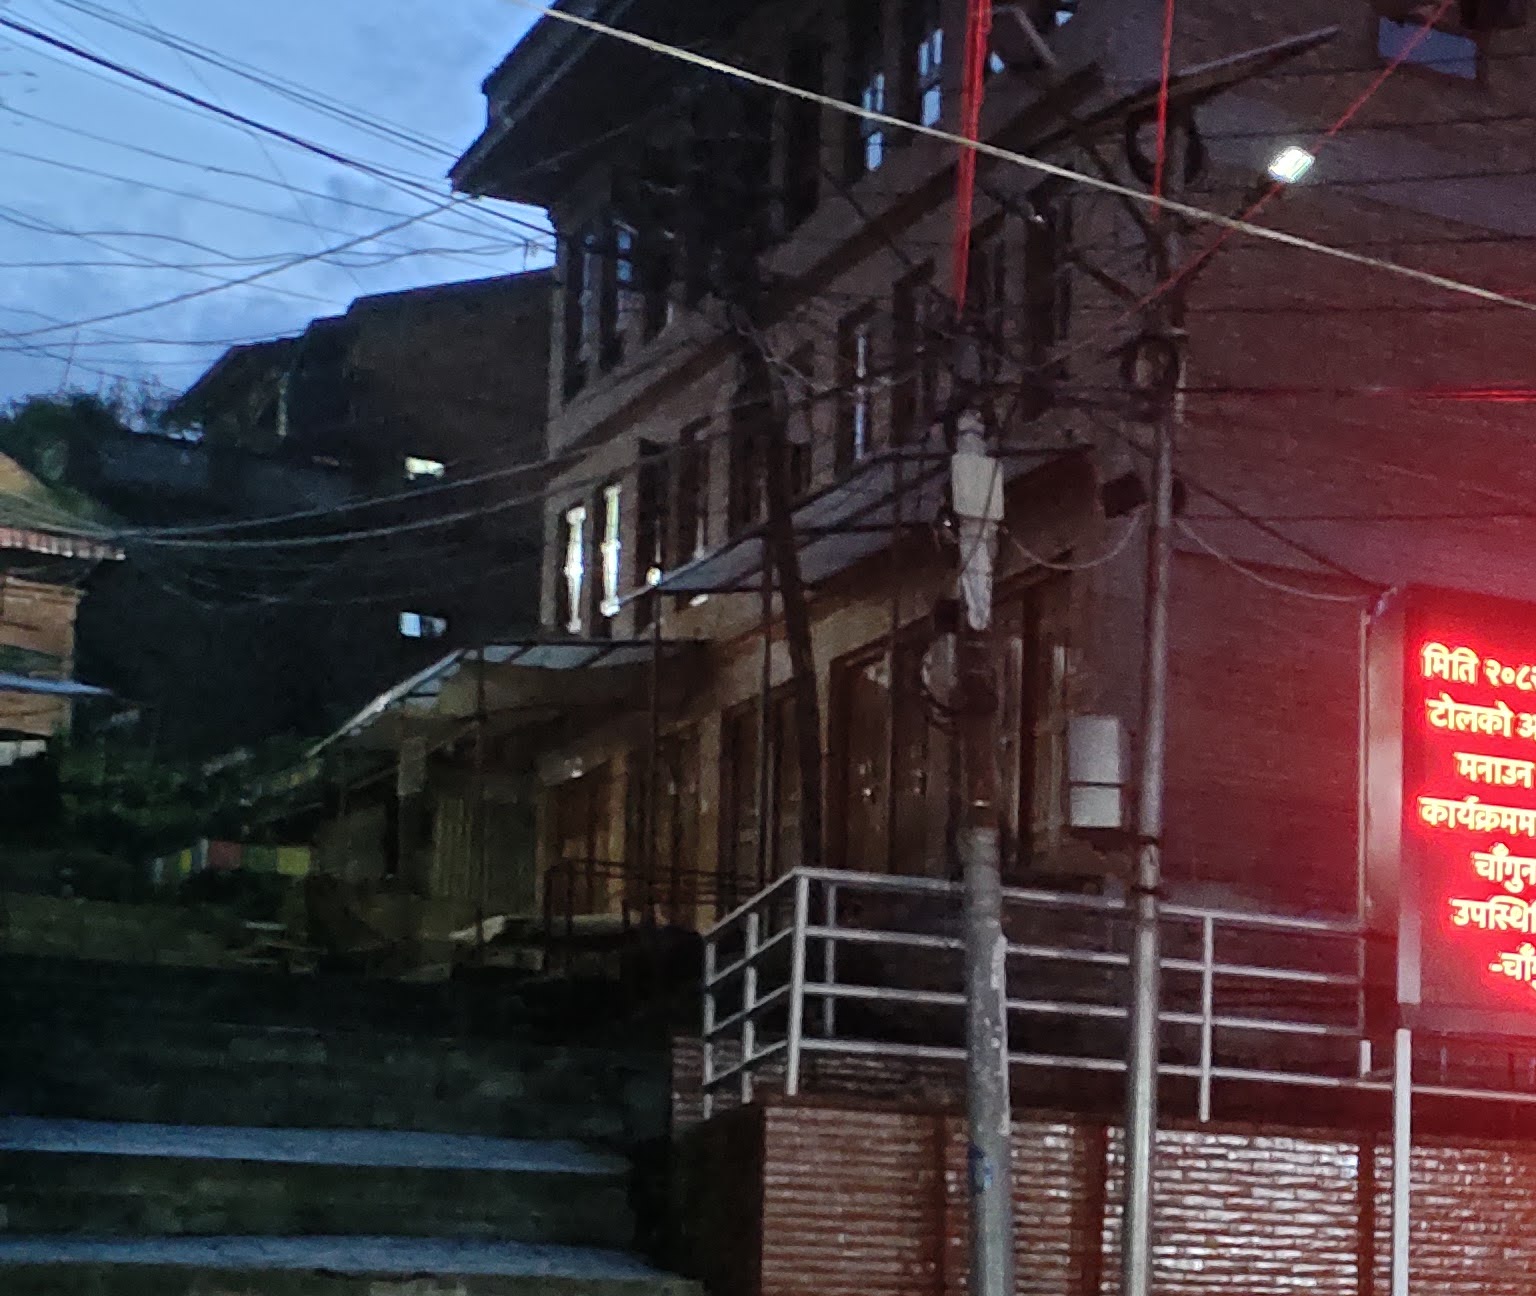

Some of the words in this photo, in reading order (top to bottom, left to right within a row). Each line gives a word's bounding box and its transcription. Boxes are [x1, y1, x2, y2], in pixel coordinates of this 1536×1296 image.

[1421, 641, 1479, 684] मिति
[1424, 692, 1514, 738] टोलको
[1453, 751, 1535, 788] मनाउन
